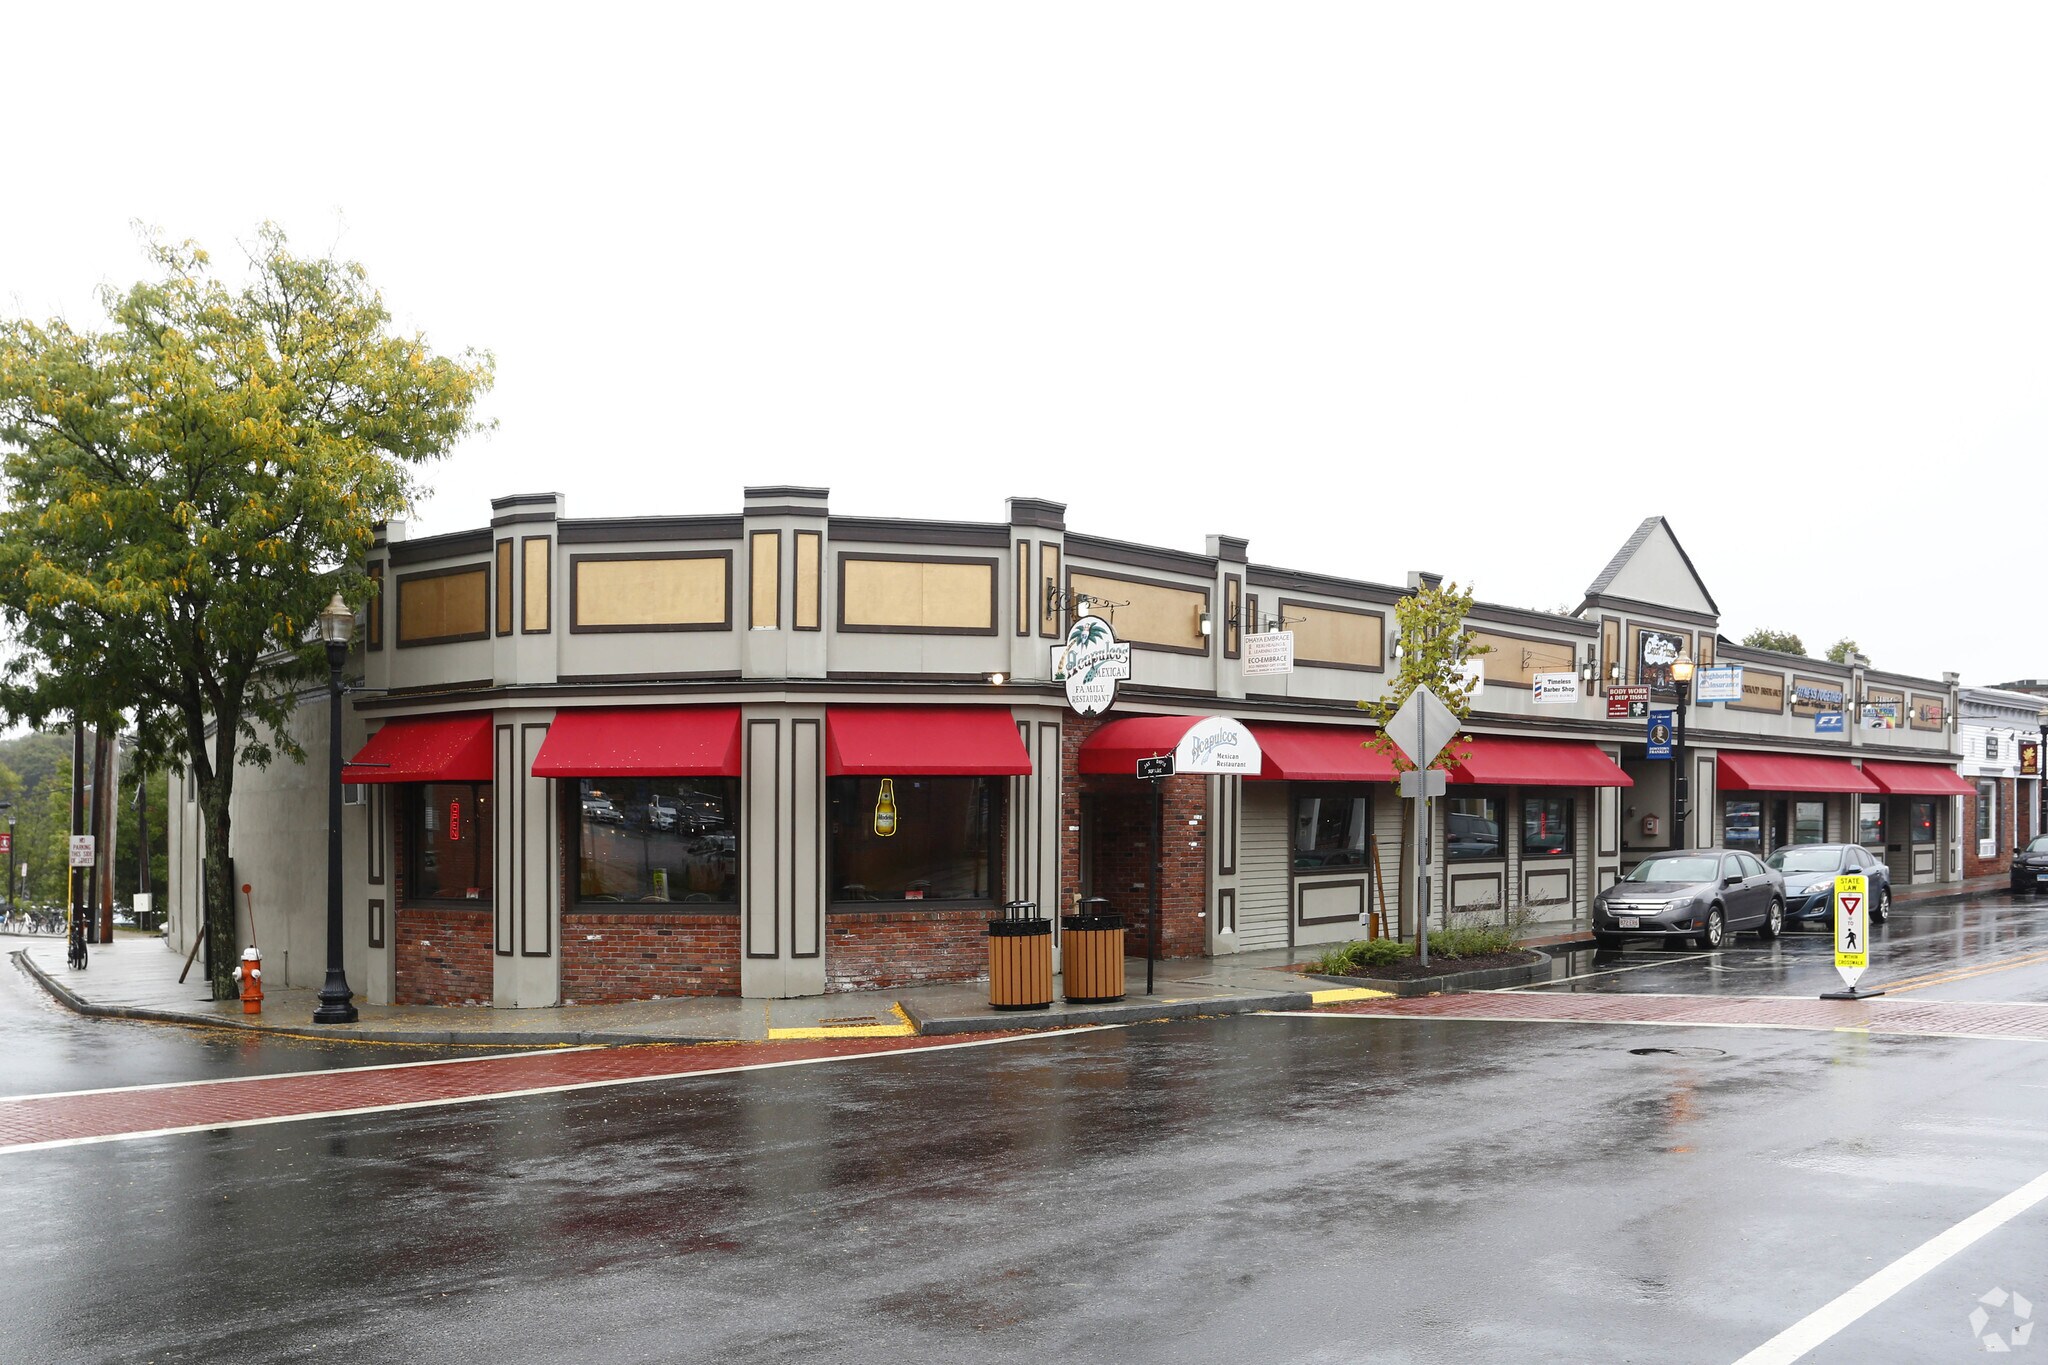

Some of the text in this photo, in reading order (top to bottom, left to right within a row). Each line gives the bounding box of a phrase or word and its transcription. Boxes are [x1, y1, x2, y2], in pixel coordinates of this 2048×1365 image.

[1264, 634, 1290, 642] EMBRACE
[1066, 641, 1128, 680] Acapulcos
[1248, 655, 1287, 664] ECO-EMBRACE
[1095, 667, 1127, 678] MEXICAN
[1701, 672, 1740, 680] Neighborhood
[1075, 685, 1105, 693] FAMILY
[1796, 686, 1817, 700] FITNESS
[1816, 688, 1843, 702] TOGETHER
[1072, 694, 1110, 704] RESTAURANT
[1818, 715, 1841, 725] FT
[1191, 726, 1238, 765] Acapulcos
[451, 804, 459, 838] OPEN
